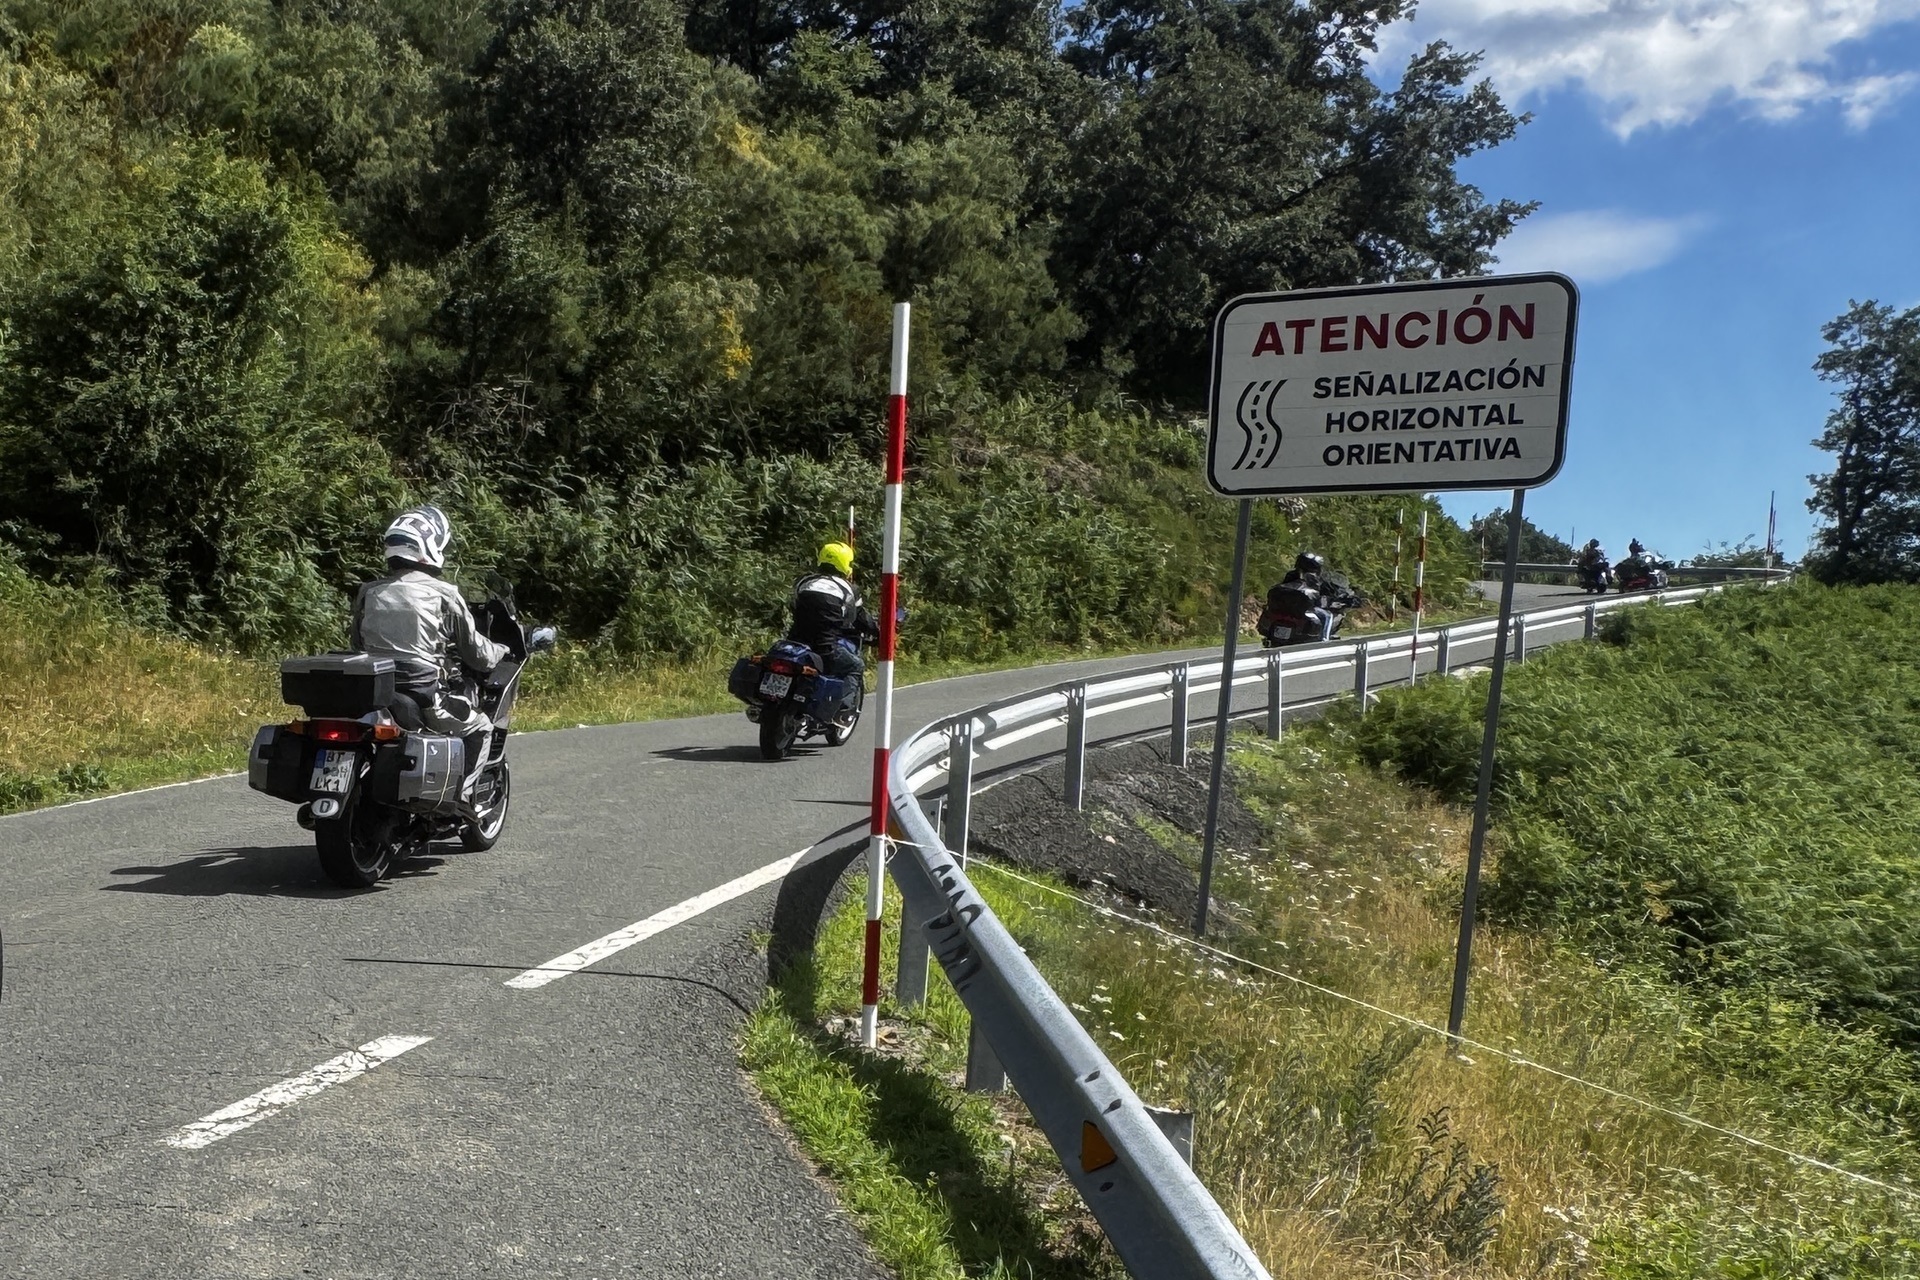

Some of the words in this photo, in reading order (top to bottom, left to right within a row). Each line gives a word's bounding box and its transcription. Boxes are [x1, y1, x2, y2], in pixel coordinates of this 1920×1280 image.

[1252, 294, 1535, 357] ATENCIÓN
[1313, 358, 1545, 398] SEÑALIZACIÓN
[1325, 403, 1524, 433] HORIZONTAL
[1323, 437, 1521, 466] ORIENTATIVA
[319, 800, 331, 813] D
